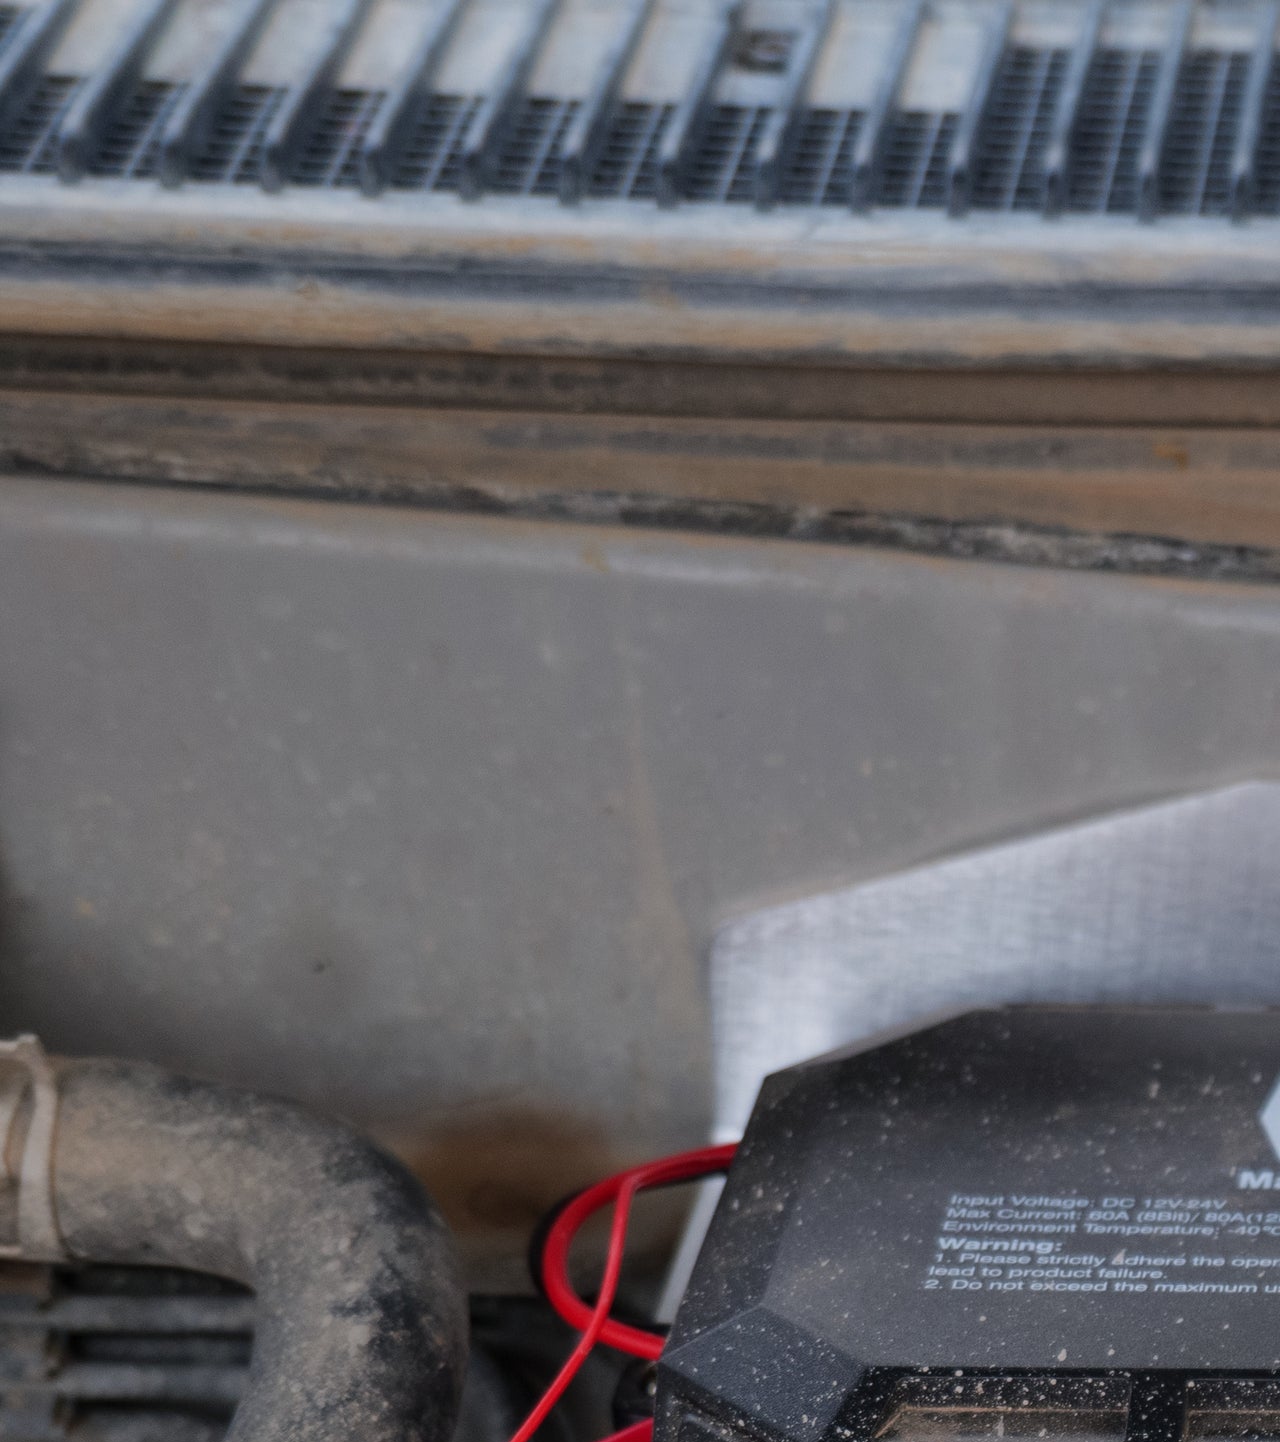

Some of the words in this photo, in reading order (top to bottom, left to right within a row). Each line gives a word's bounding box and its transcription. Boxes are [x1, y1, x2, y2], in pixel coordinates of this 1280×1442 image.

[950, 1195, 1004, 1208] Input
[1011, 1195, 1096, 1210] Voltage:
[1102, 1198, 1135, 1209] DC
[946, 1208, 992, 1219] Max
[998, 1209, 1083, 1221] Current:
[942, 1221, 1077, 1233] Environment
[1085, 1222, 1220, 1237] Temperature:
[937, 1237, 1063, 1254] Warning:
[934, 1253, 952, 1264] 1.
[959, 1253, 1032, 1265] Please
[1037, 1253, 1106, 1267] strictly
[1192, 1256, 1226, 1267] the
[928, 1267, 975, 1277] lead
[981, 1267, 1003, 1277] to
[1008, 1267, 1092, 1280] product
[1098, 1267, 1168, 1279] failure.
[923, 1279, 943, 1290] 2.
[951, 1280, 983, 1290] Do
[989, 1280, 1024, 1291] not
[1030, 1280, 1107, 1292] exceed
[1113, 1281, 1148, 1292] the
[1153, 1282, 1258, 1294] maximum
